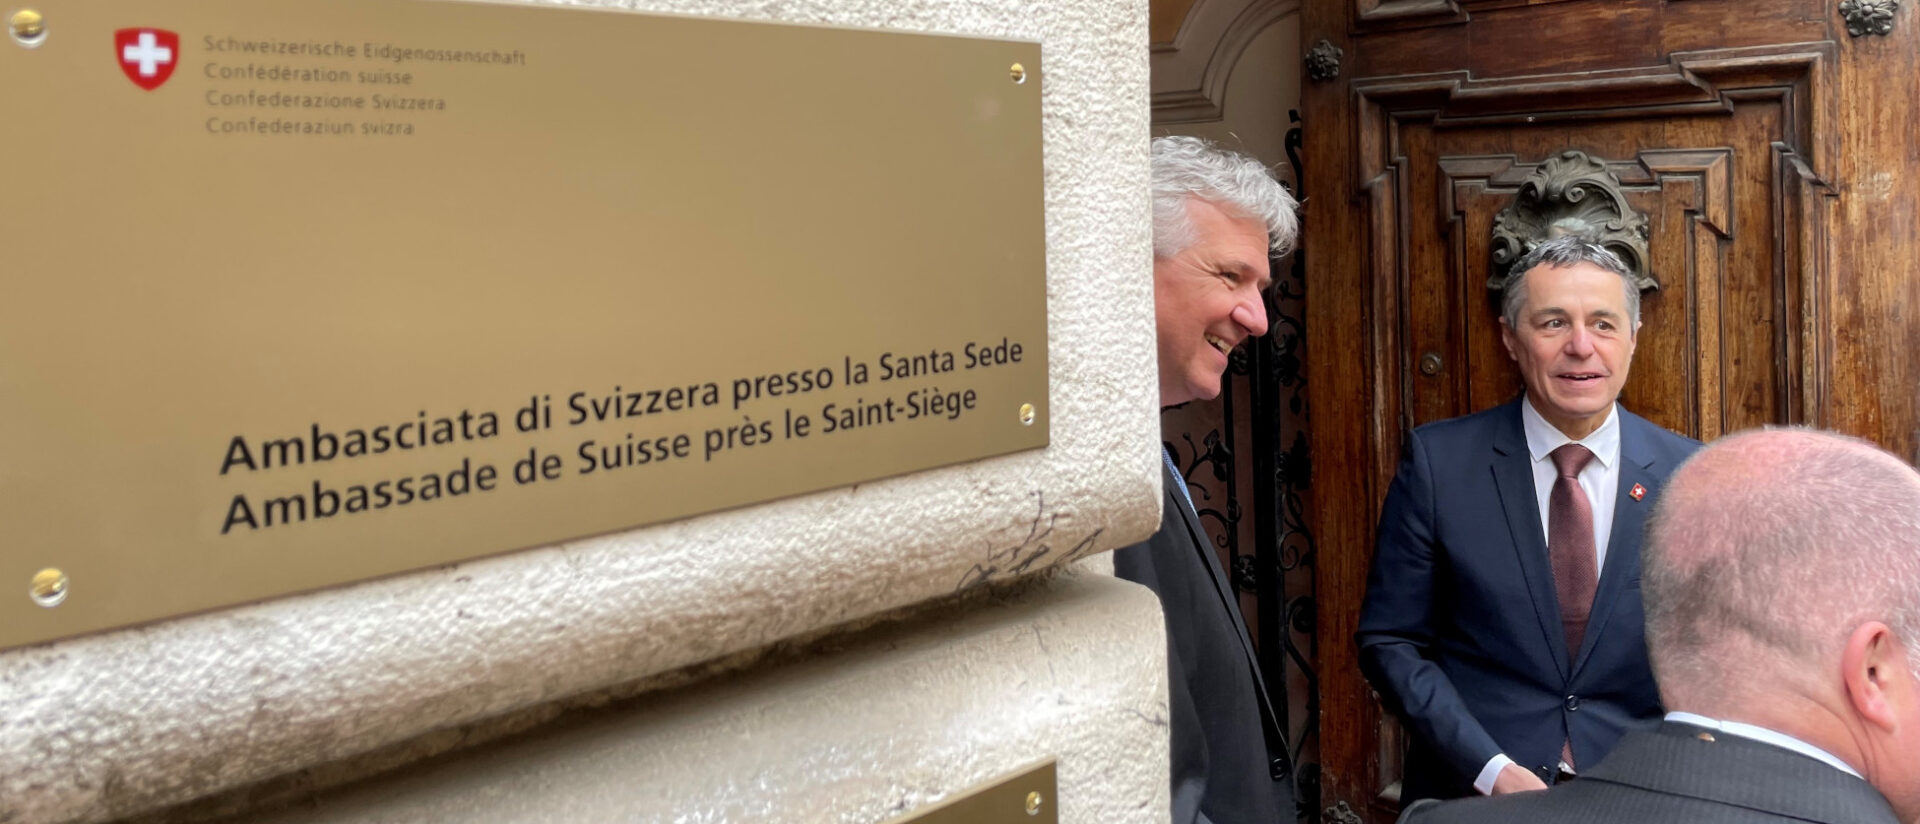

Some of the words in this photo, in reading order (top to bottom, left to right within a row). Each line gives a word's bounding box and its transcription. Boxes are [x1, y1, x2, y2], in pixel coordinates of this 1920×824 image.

[203, 35, 357, 58] Schweizerische
[363, 42, 526, 66] Eidgenossenschaft
[204, 62, 351, 83] Confédération
[358, 69, 413, 85] suisse
[205, 89, 365, 110] Confederazione
[372, 94, 446, 112] Svizzera
[206, 116, 355, 135] Confederaziun
[361, 120, 415, 136] svizra
[219, 409, 499, 475] Ambasciata
[515, 395, 552, 432] di
[568, 383, 719, 426] Svizzera
[733, 366, 833, 409] presso
[845, 356, 868, 386] la
[880, 350, 955, 381] Santa
[965, 337, 1023, 369] Sede
[220, 458, 497, 535] Ambassade
[513, 448, 563, 485] de
[578, 433, 690, 475] Suisse
[705, 416, 773, 461] près
[785, 409, 810, 439] le
[823, 386, 976, 434] Saint-Siège
